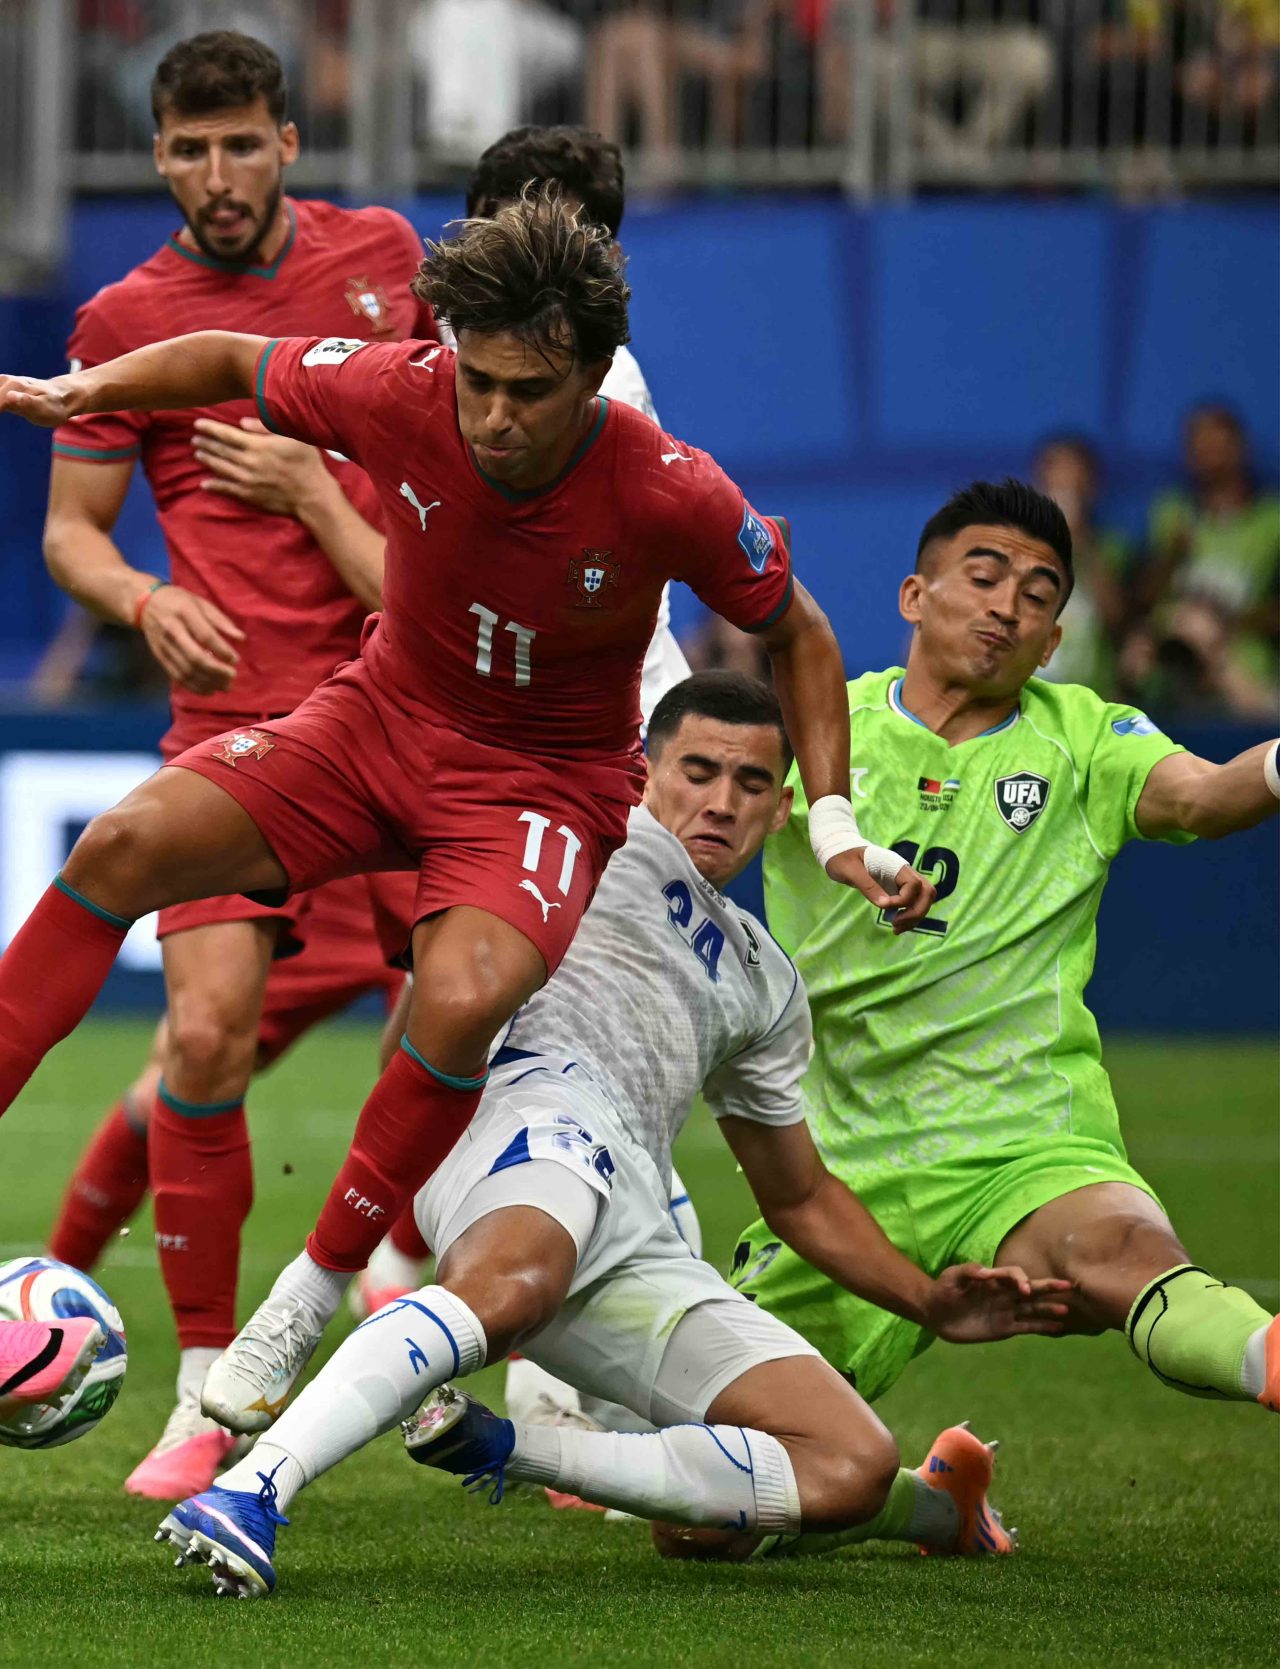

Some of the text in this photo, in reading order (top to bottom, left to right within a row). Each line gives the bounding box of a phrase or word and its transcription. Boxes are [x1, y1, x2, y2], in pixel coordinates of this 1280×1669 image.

[467, 601, 537, 687] 11
[1003, 783, 1041, 805] UFA
[517, 810, 582, 897] 11
[661, 879, 726, 985] 24
